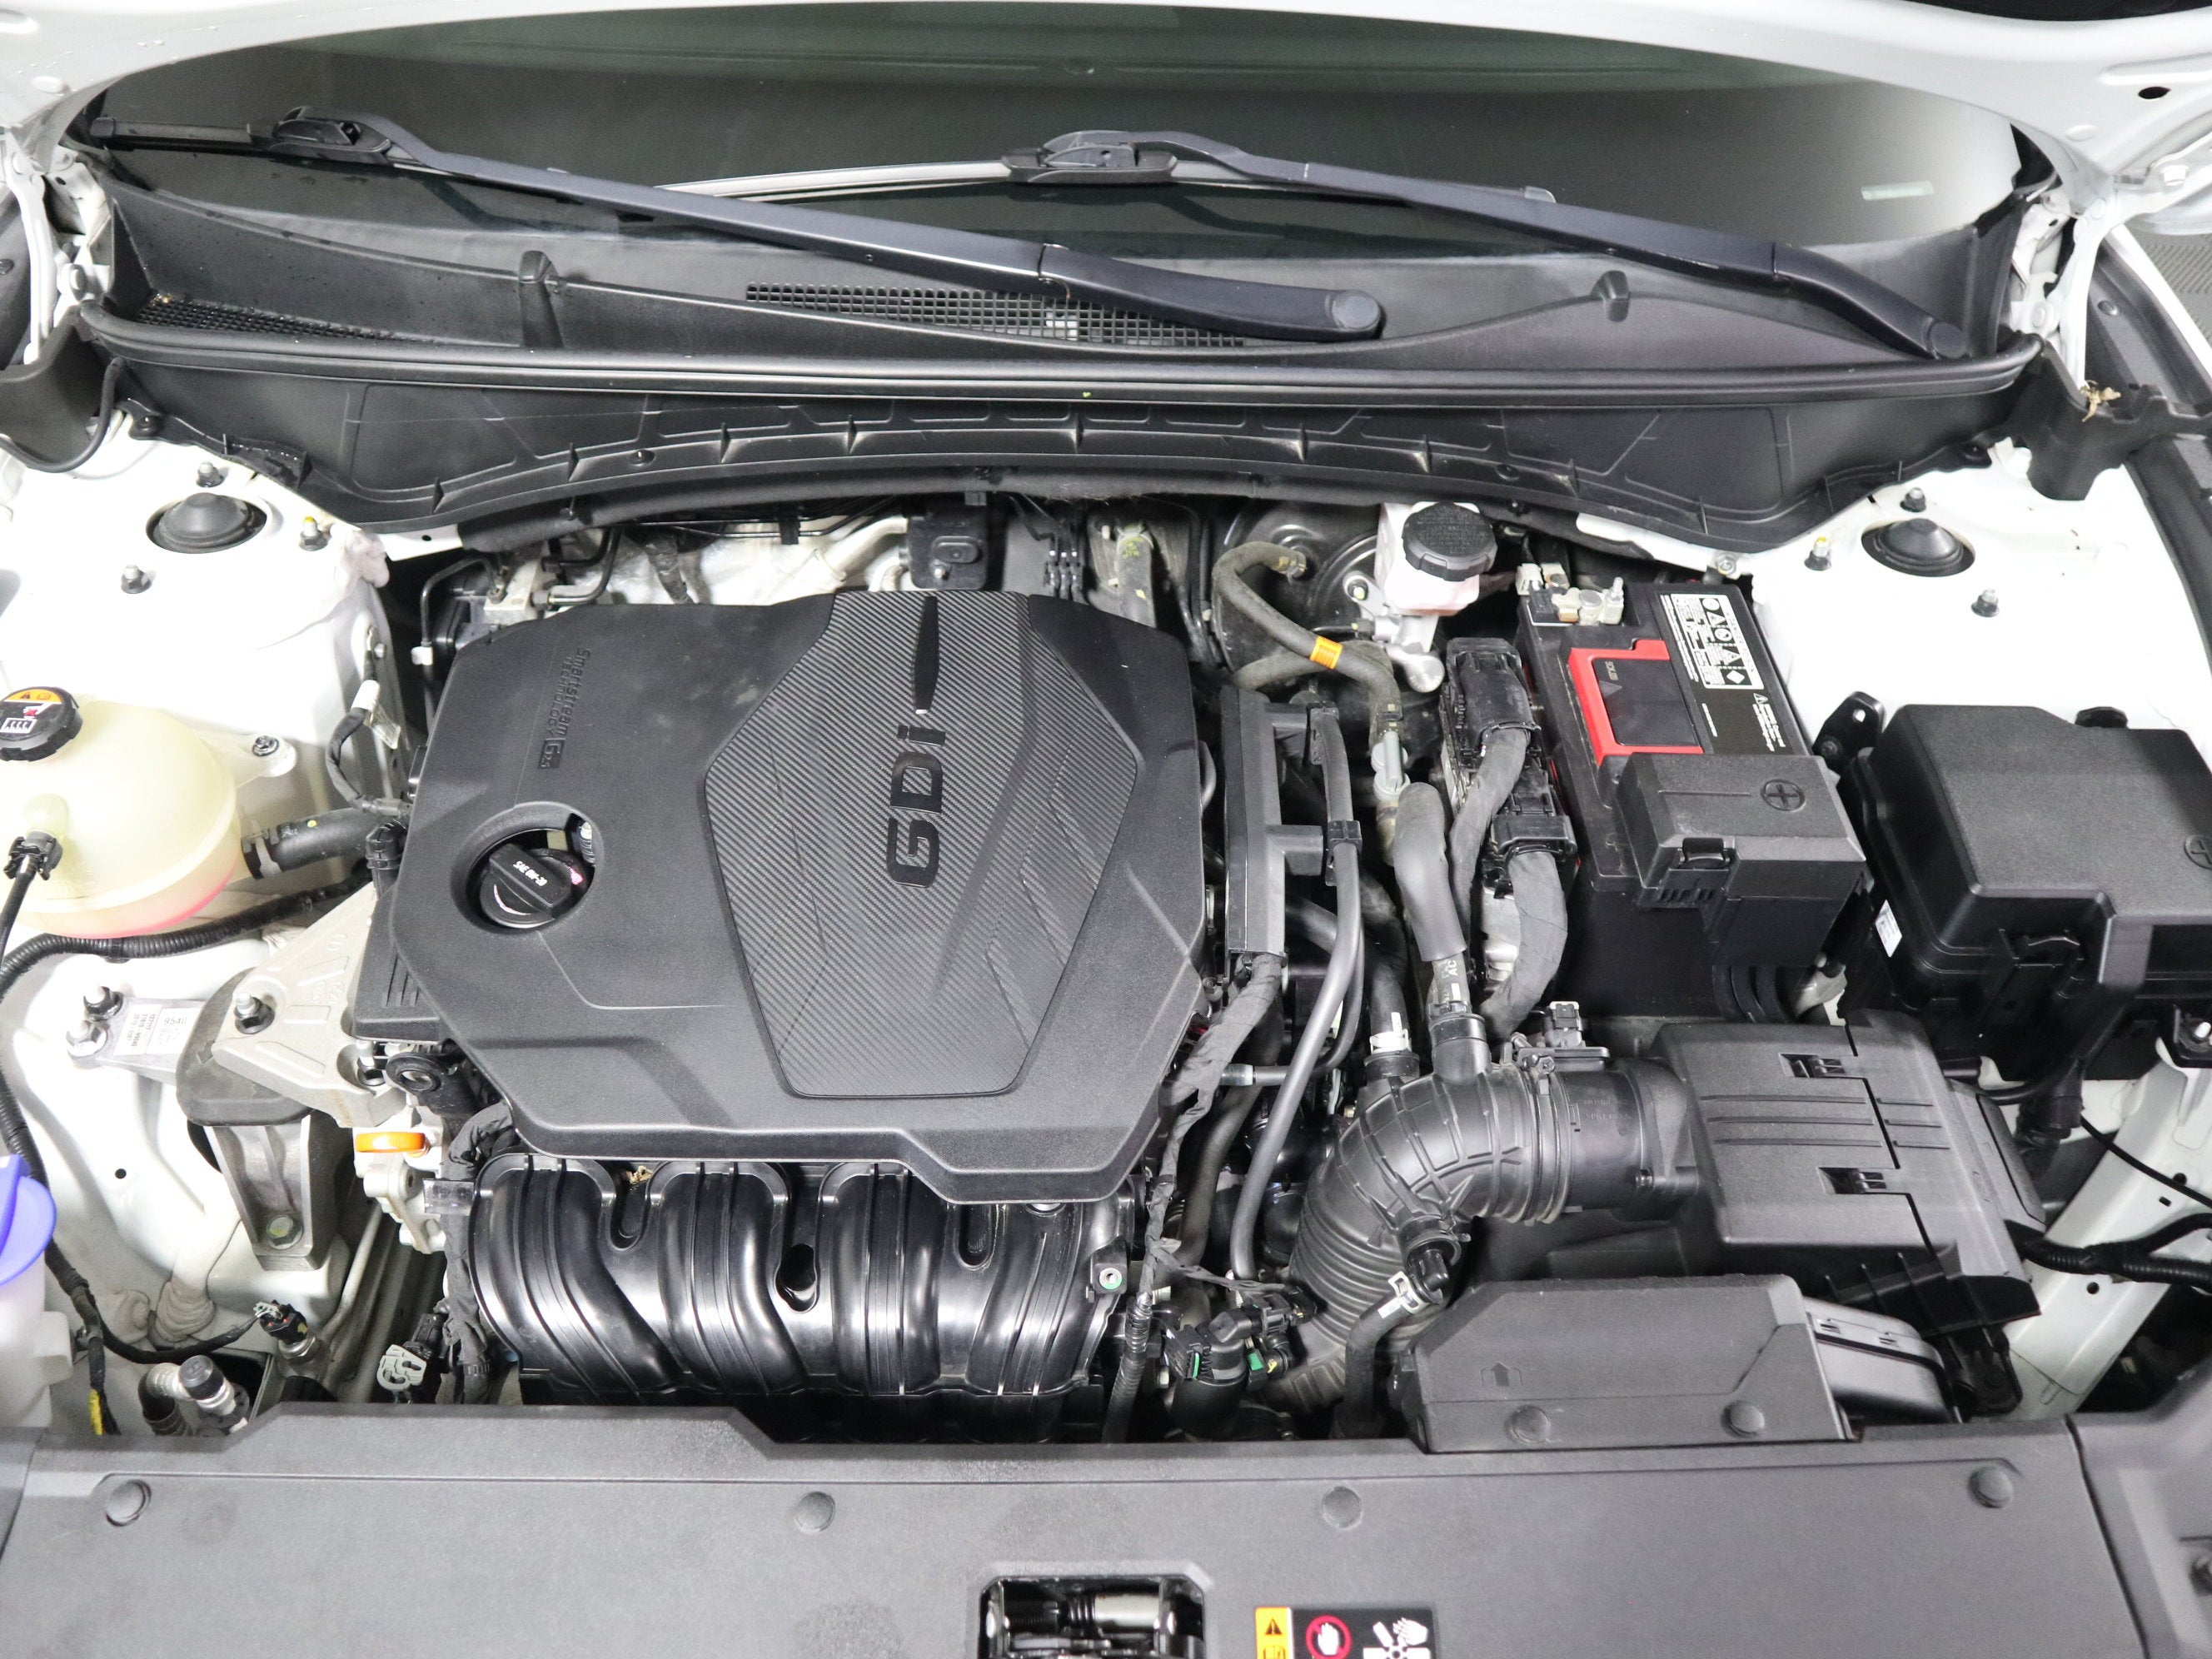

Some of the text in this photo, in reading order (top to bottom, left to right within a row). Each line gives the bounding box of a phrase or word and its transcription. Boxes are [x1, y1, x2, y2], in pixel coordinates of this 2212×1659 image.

[546, 656, 573, 736] TECHNOLOGY
[556, 648, 590, 735] Smartstream
[512, 860, 548, 887] SAE 0W-20
[163, 1017, 187, 1025] 9540
